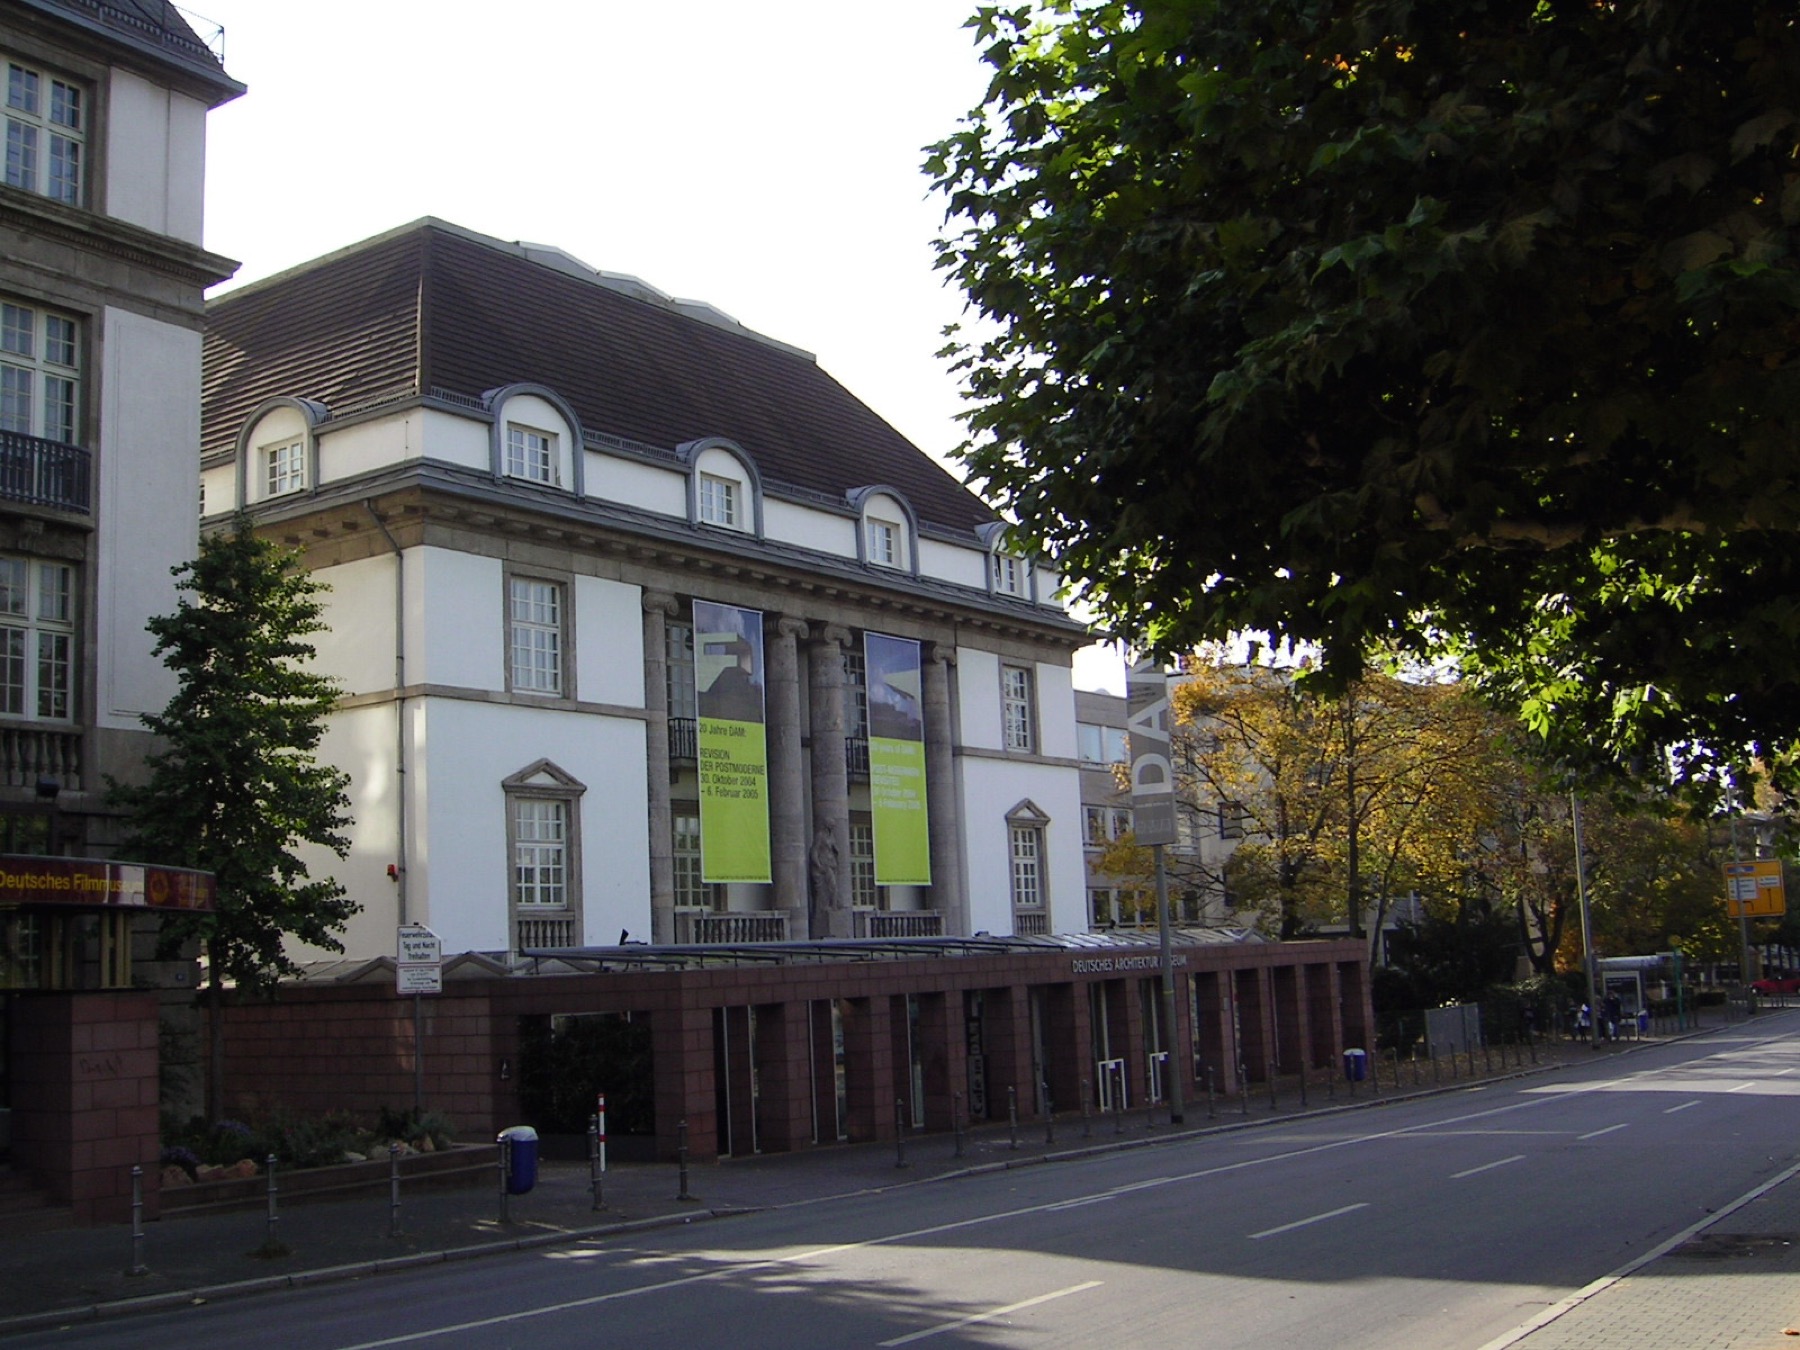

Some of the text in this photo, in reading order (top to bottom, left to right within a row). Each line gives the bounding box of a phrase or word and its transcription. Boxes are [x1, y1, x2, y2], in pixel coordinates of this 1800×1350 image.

[709, 724, 728, 736] Jahre
[700, 747, 730, 760] REVISION
[701, 760, 765, 775] DER POSTMODERNE
[712, 773, 739, 786] Oktober
[715, 786, 741, 798] Februar
[0, 870, 71, 891] Deutsches
[422, 941, 435, 949] Nacht
[1072, 959, 1113, 973] DEUTSCHES
